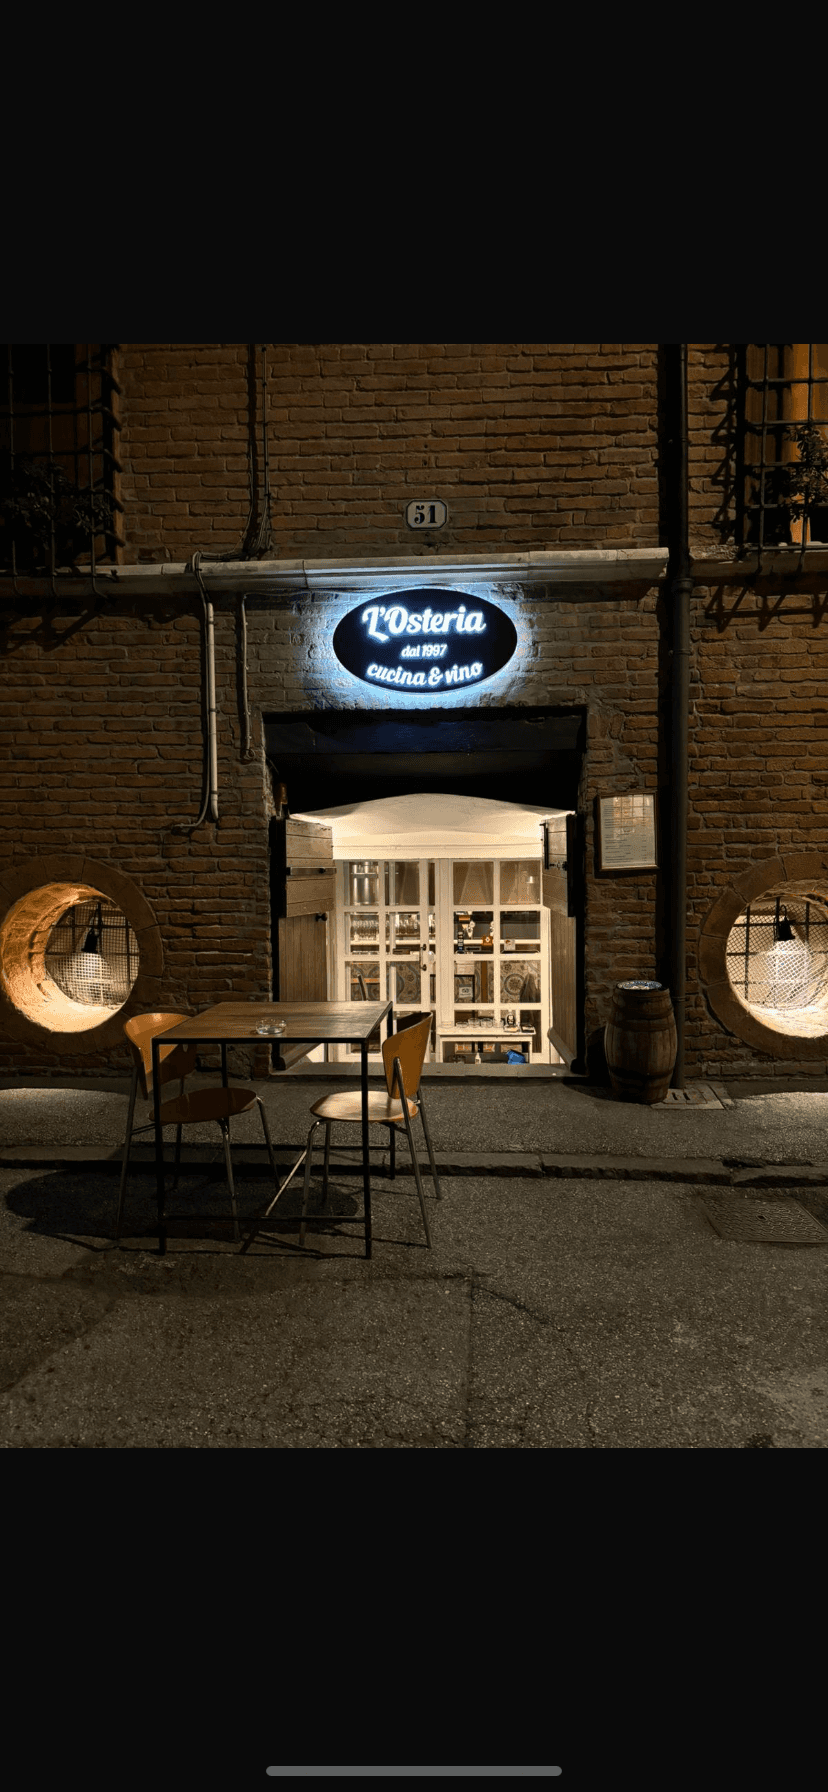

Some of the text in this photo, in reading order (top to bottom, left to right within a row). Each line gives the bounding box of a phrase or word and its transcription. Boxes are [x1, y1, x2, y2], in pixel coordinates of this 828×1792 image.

[414, 505, 438, 524] 51
[362, 605, 486, 641] L'Osteria
[401, 644, 447, 657] dal 1997
[367, 662, 483, 686] cucina & vino
